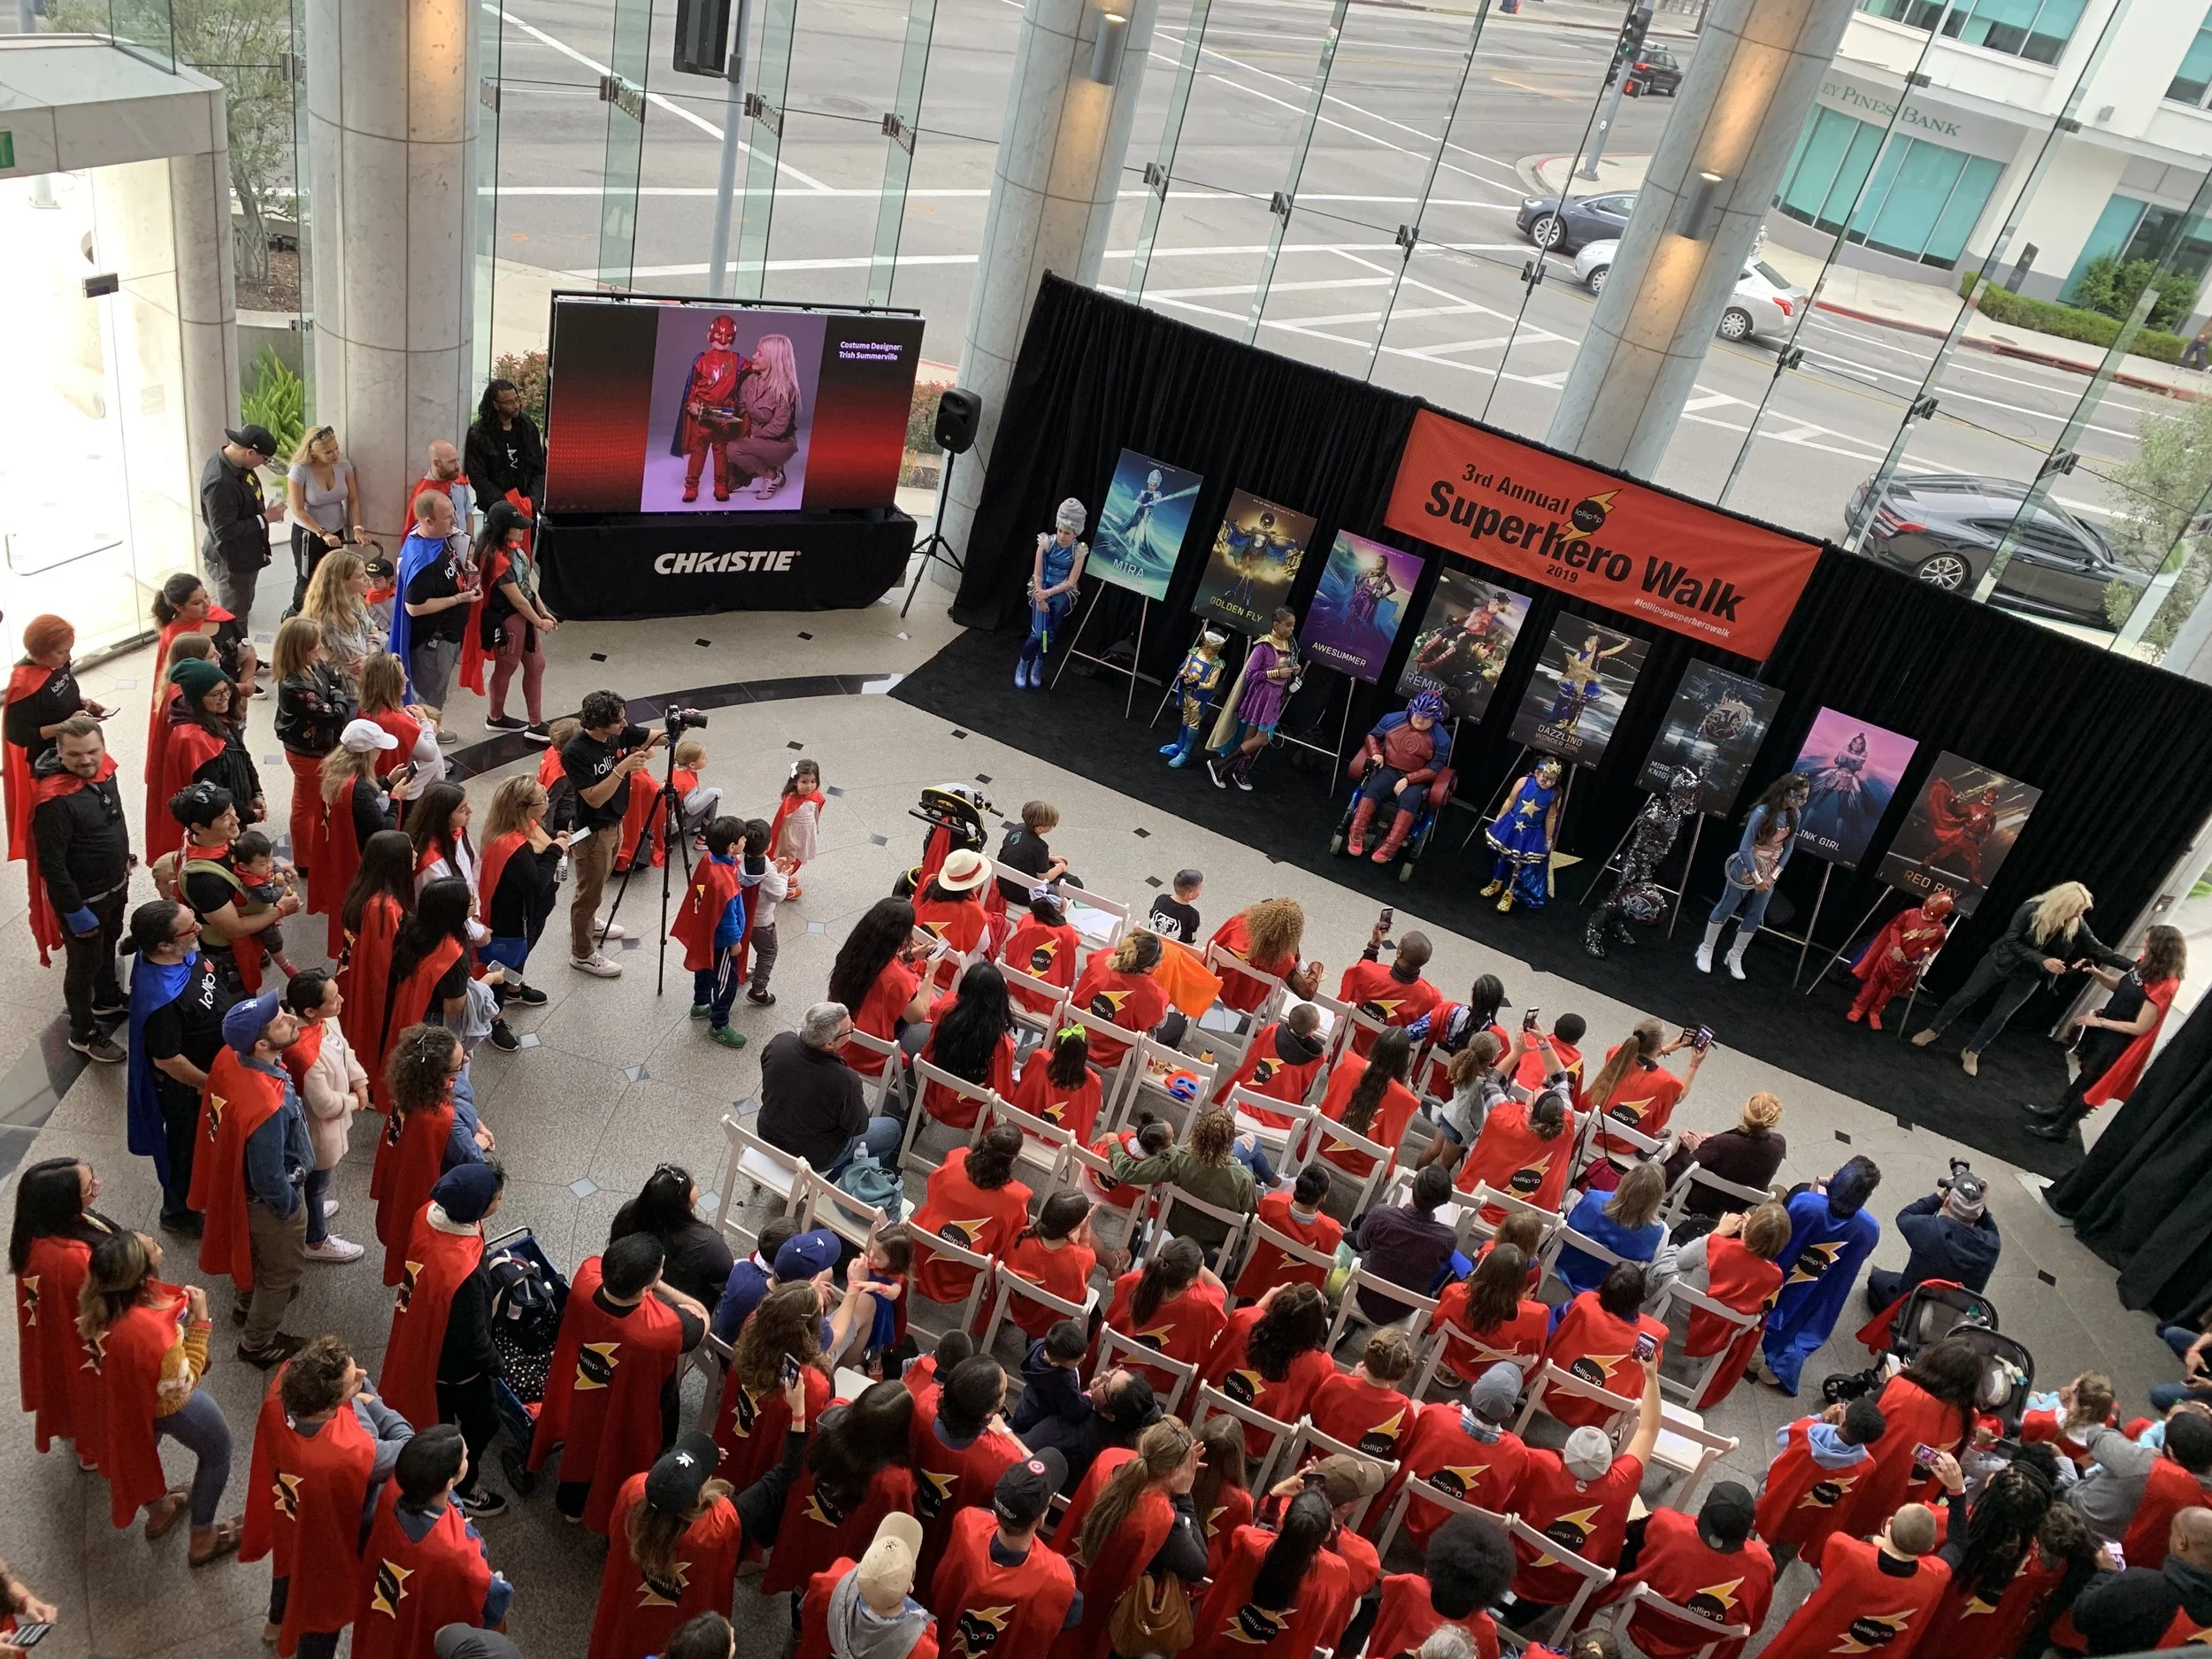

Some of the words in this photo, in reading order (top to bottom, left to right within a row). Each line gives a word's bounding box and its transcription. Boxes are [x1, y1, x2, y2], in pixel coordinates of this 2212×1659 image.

[1823, 82, 1840, 96] EY
[1840, 86, 1899, 117] PINES
[1901, 106, 1962, 136] BANK
[856, 351, 898, 361] Summerville
[871, 342, 902, 352] Designer:
[1462, 464, 1494, 488] 3rd
[1496, 476, 1571, 515] Annual
[654, 551, 795, 575] CHRISTIE
[1425, 480, 1633, 582] Superhero
[1640, 556, 1747, 623] Walk
[1113, 558, 1144, 579] MIRA
[1546, 564, 1578, 583] 2019
[1210, 595, 1244, 616] GOLDEN
[1245, 611, 1263, 623] FLY
[1633, 597, 1731, 638] #lollipopsuperherowalk
[1311, 641, 1367, 667] AWESUMMER
[1404, 672, 1446, 695] REMIX
[1535, 732, 1563, 746] WONDER
[1564, 743, 1579, 753] GIRL
[1537, 724, 1584, 747] DAZZLING
[1650, 760, 1671, 772] MIRR
[1795, 829, 1817, 841] LINK
[1818, 837, 1840, 851] GIRL
[1903, 870, 1932, 888] RED
